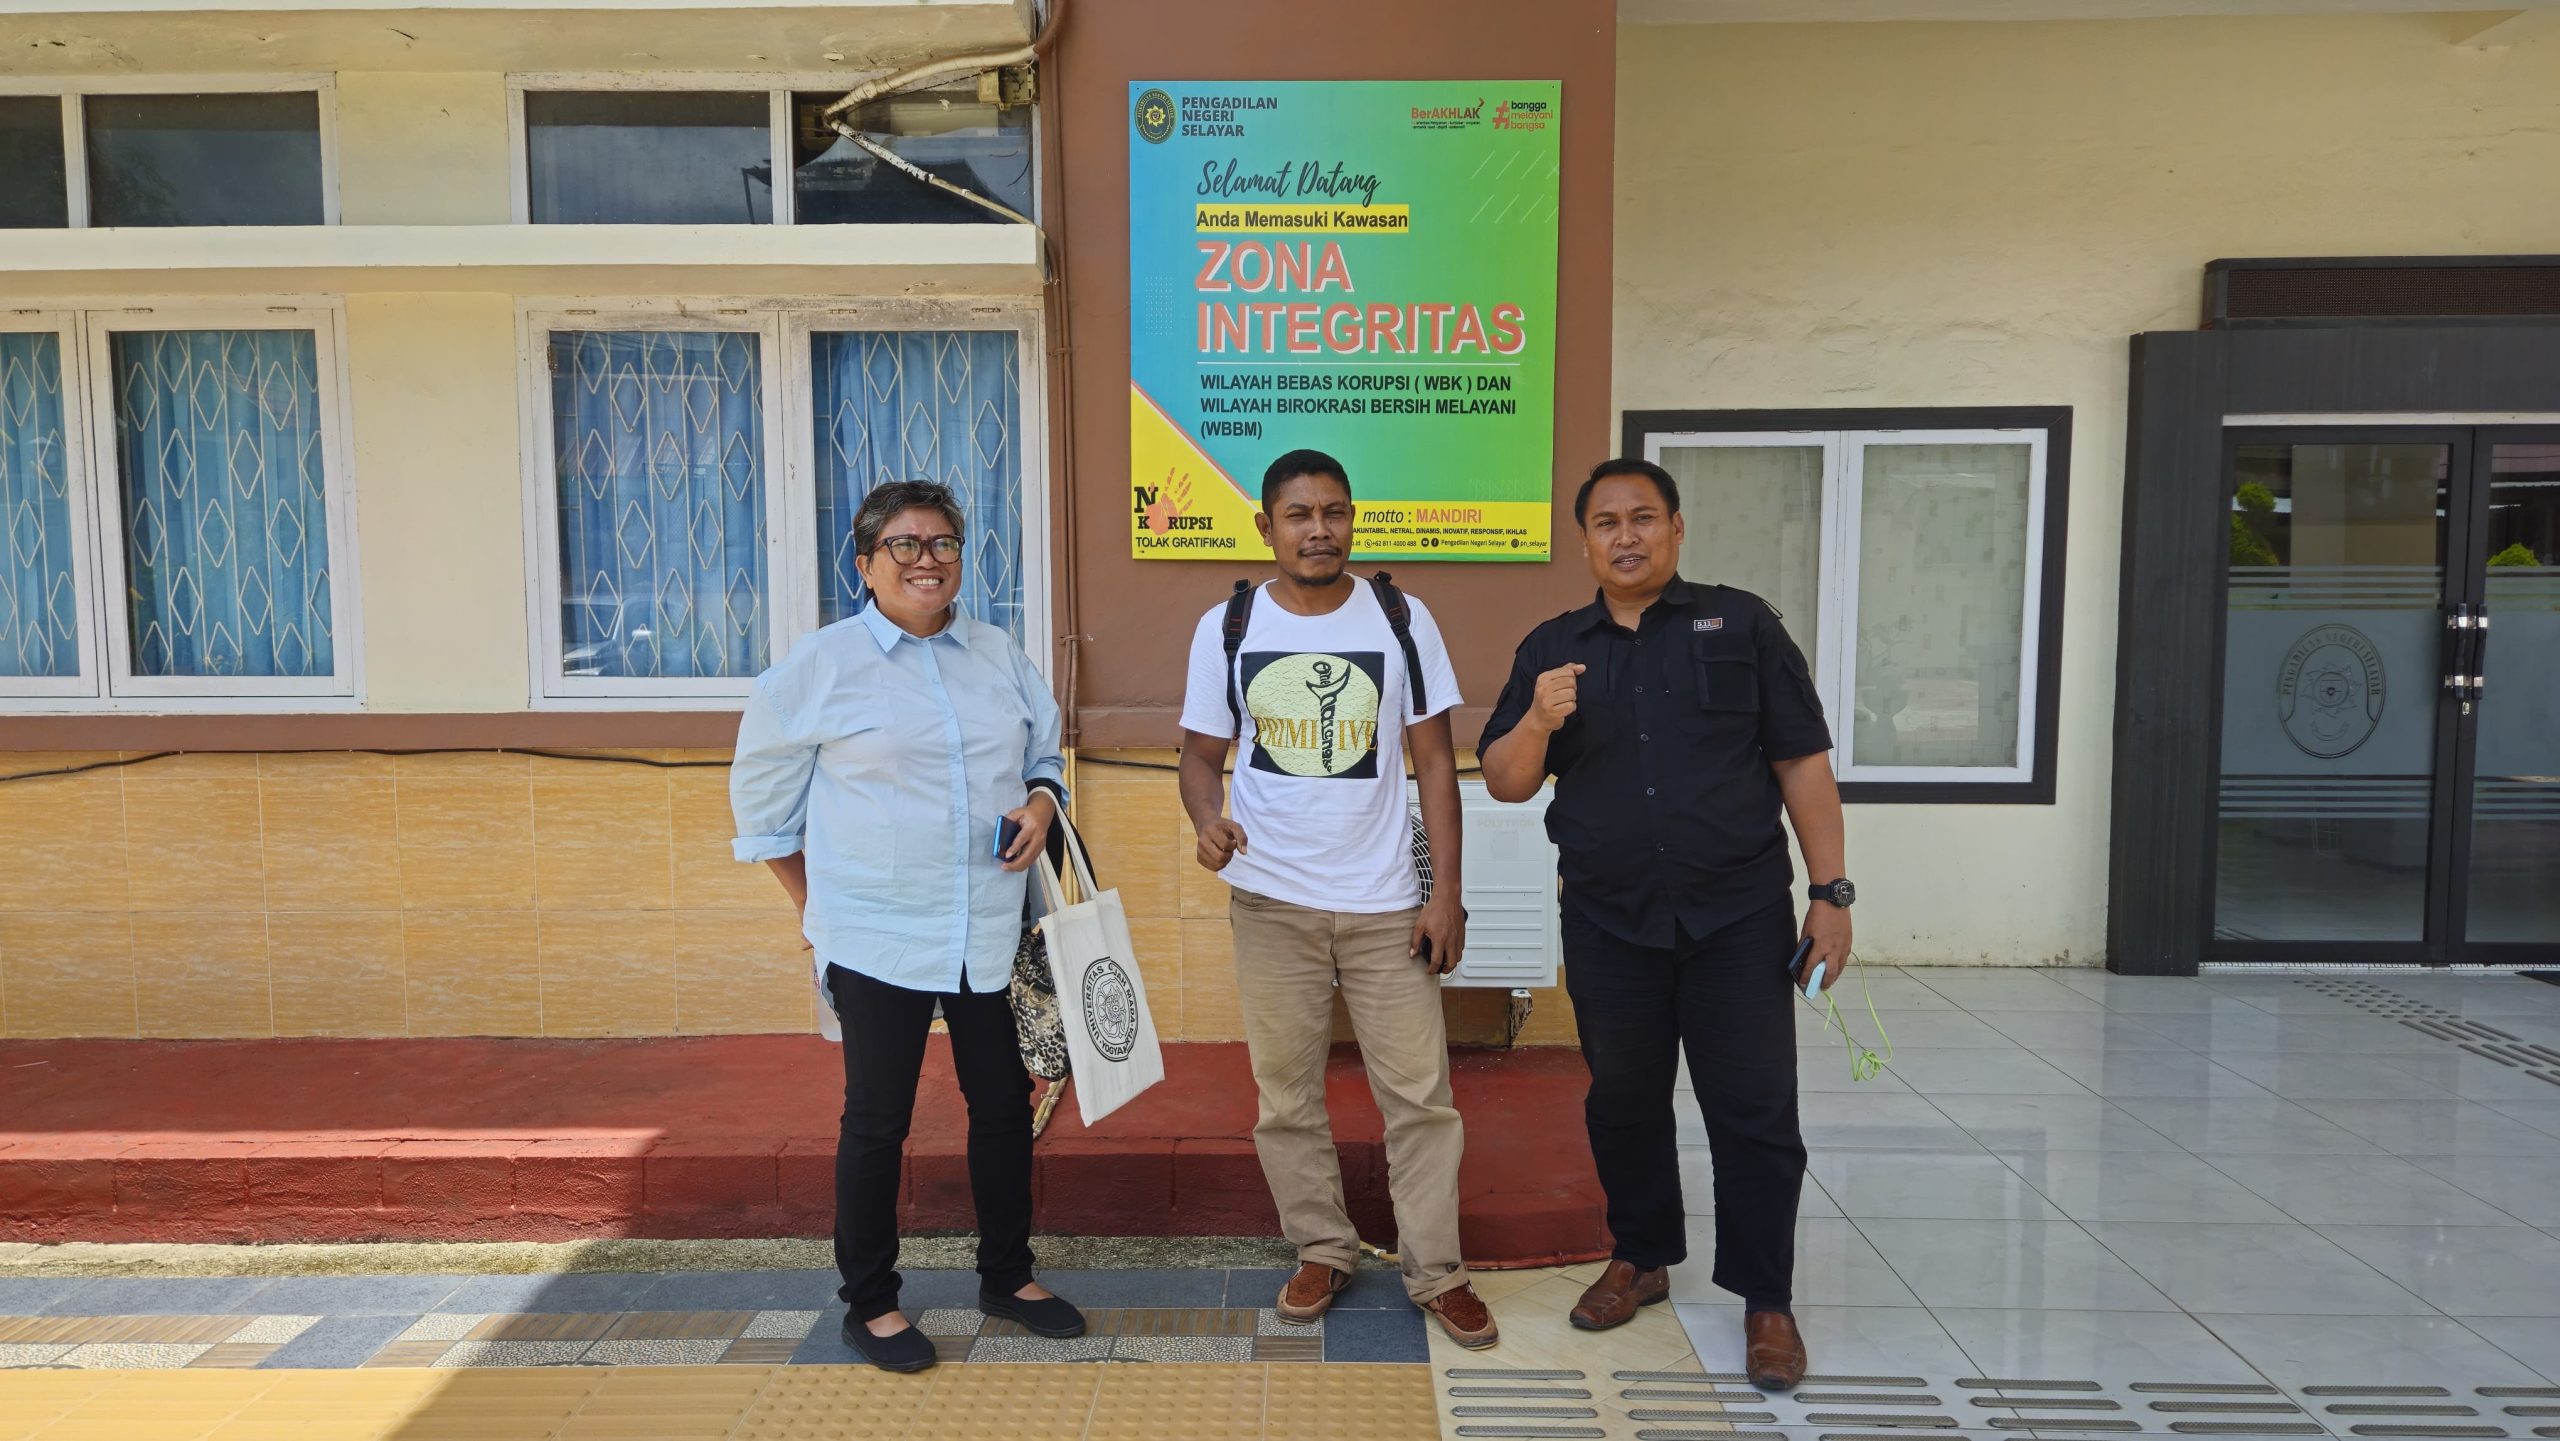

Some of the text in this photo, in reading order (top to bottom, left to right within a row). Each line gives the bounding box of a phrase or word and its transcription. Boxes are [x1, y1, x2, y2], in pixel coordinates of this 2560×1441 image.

[1182, 96, 1278, 110] PENGADILAN
[1511, 100, 1547, 112] bangga
[1182, 110, 1235, 122] NEGERI
[1411, 106, 1480, 119] BerAKHLAK
[1511, 110, 1553, 121] melayani
[1182, 124, 1245, 137] SELAYAR
[1511, 121, 1546, 132] bangsa
[1196, 157, 1382, 208] Selamat Datang
[1196, 210, 1408, 228] Anda Memasuki Kawasan
[1195, 240, 1355, 292] ZONA
[1197, 302, 1526, 354] INTEGRITAS
[1200, 374, 1272, 390] WILAYAH
[1277, 375, 1332, 390] BEBAS
[1337, 375, 1410, 391] KORUPSI
[1477, 376, 1511, 391] DAN
[1200, 398, 1516, 414] WILAYAH BIROKRASI BERSIH MELAYANI
[1200, 421, 1263, 439] (WBBM)
[1137, 515, 1213, 530] KRUPSI
[1363, 508, 1404, 523] motto
[1416, 508, 1482, 524] MANDIRI
[1416, 527, 1441, 535] DINAMIS,
[1442, 527, 1469, 535] INOVATIF,
[1136, 537, 1236, 549] TOLAK GRATIFIKASI
[1440, 539, 1469, 547] Pengadilan
[1086, 965, 1105, 1040] UNIVERSITAS
[1125, 989, 1136, 1023] MADA
